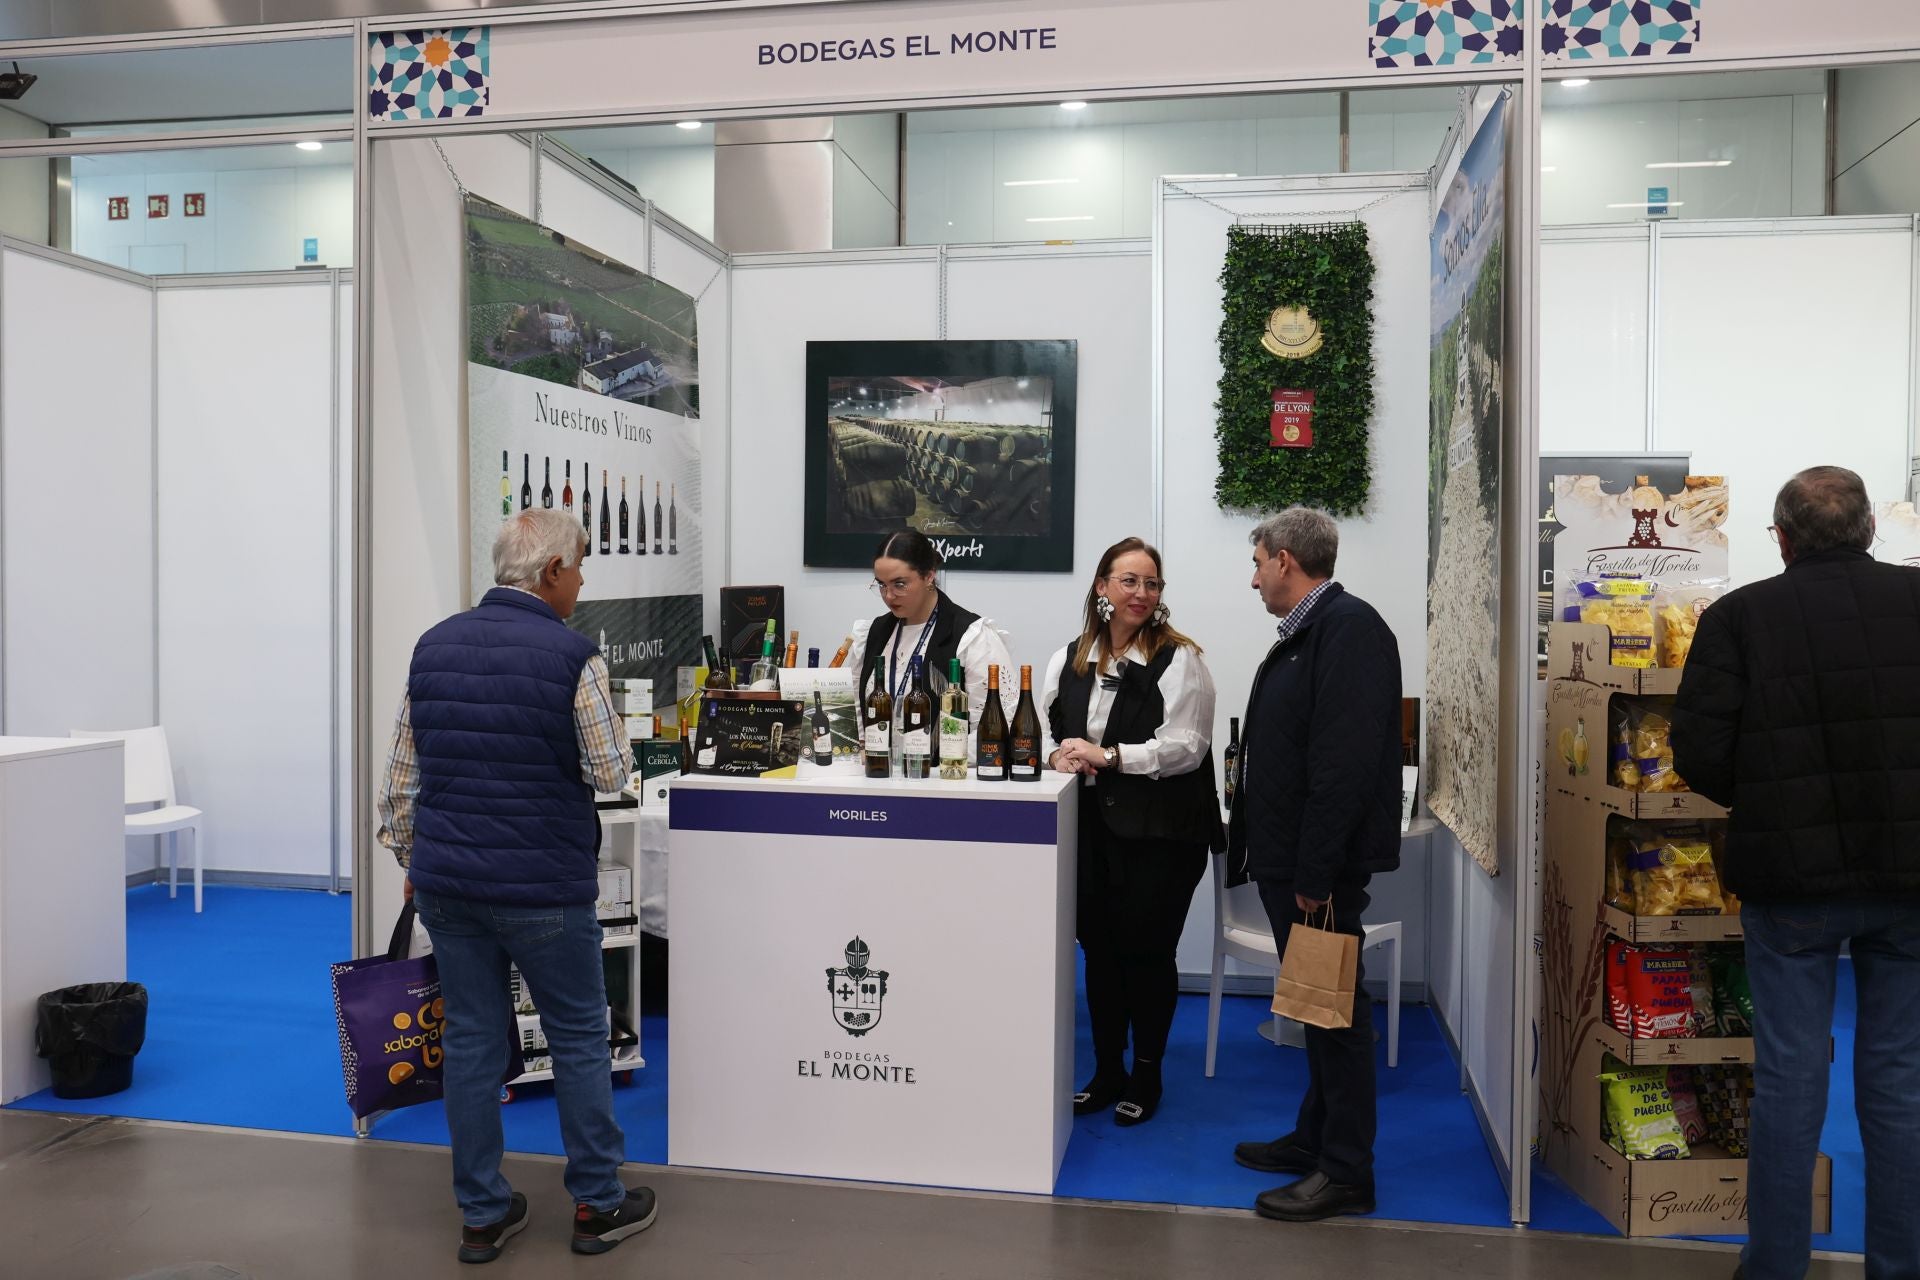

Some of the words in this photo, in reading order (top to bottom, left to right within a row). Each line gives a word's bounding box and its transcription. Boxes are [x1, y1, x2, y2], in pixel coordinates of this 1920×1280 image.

[758, 37, 896, 66] BODEGAS
[905, 34, 940, 57] EL
[951, 28, 1057, 54] MONTE
[1274, 404, 1286, 413] DE
[1287, 404, 1311, 413] LYON
[535, 392, 608, 436] Nuestros
[614, 410, 653, 445] Vinos
[1284, 416, 1300, 424] 2019
[1587, 554, 1637, 574] Castillo
[1638, 553, 1650, 565] de
[1648, 554, 1700, 576] Moriles
[612, 644, 626, 664] EL
[628, 638, 664, 661] MONTE
[647, 755, 678, 765] CEBOLLA
[829, 809, 888, 822] MORILES
[1652, 975, 1689, 984] PAPAS
[1663, 987, 1678, 996] DE
[824, 1051, 890, 1063] BODEGAS
[798, 1060, 822, 1078] EL
[831, 1063, 917, 1085] MONTE
[1630, 1081, 1664, 1094] PAPAS
[1642, 1094, 1657, 1104] DE
[1633, 1103, 1674, 1117] PUEBLO
[1648, 1191, 1721, 1223] Castillo
[1723, 1189, 1741, 1206] de
